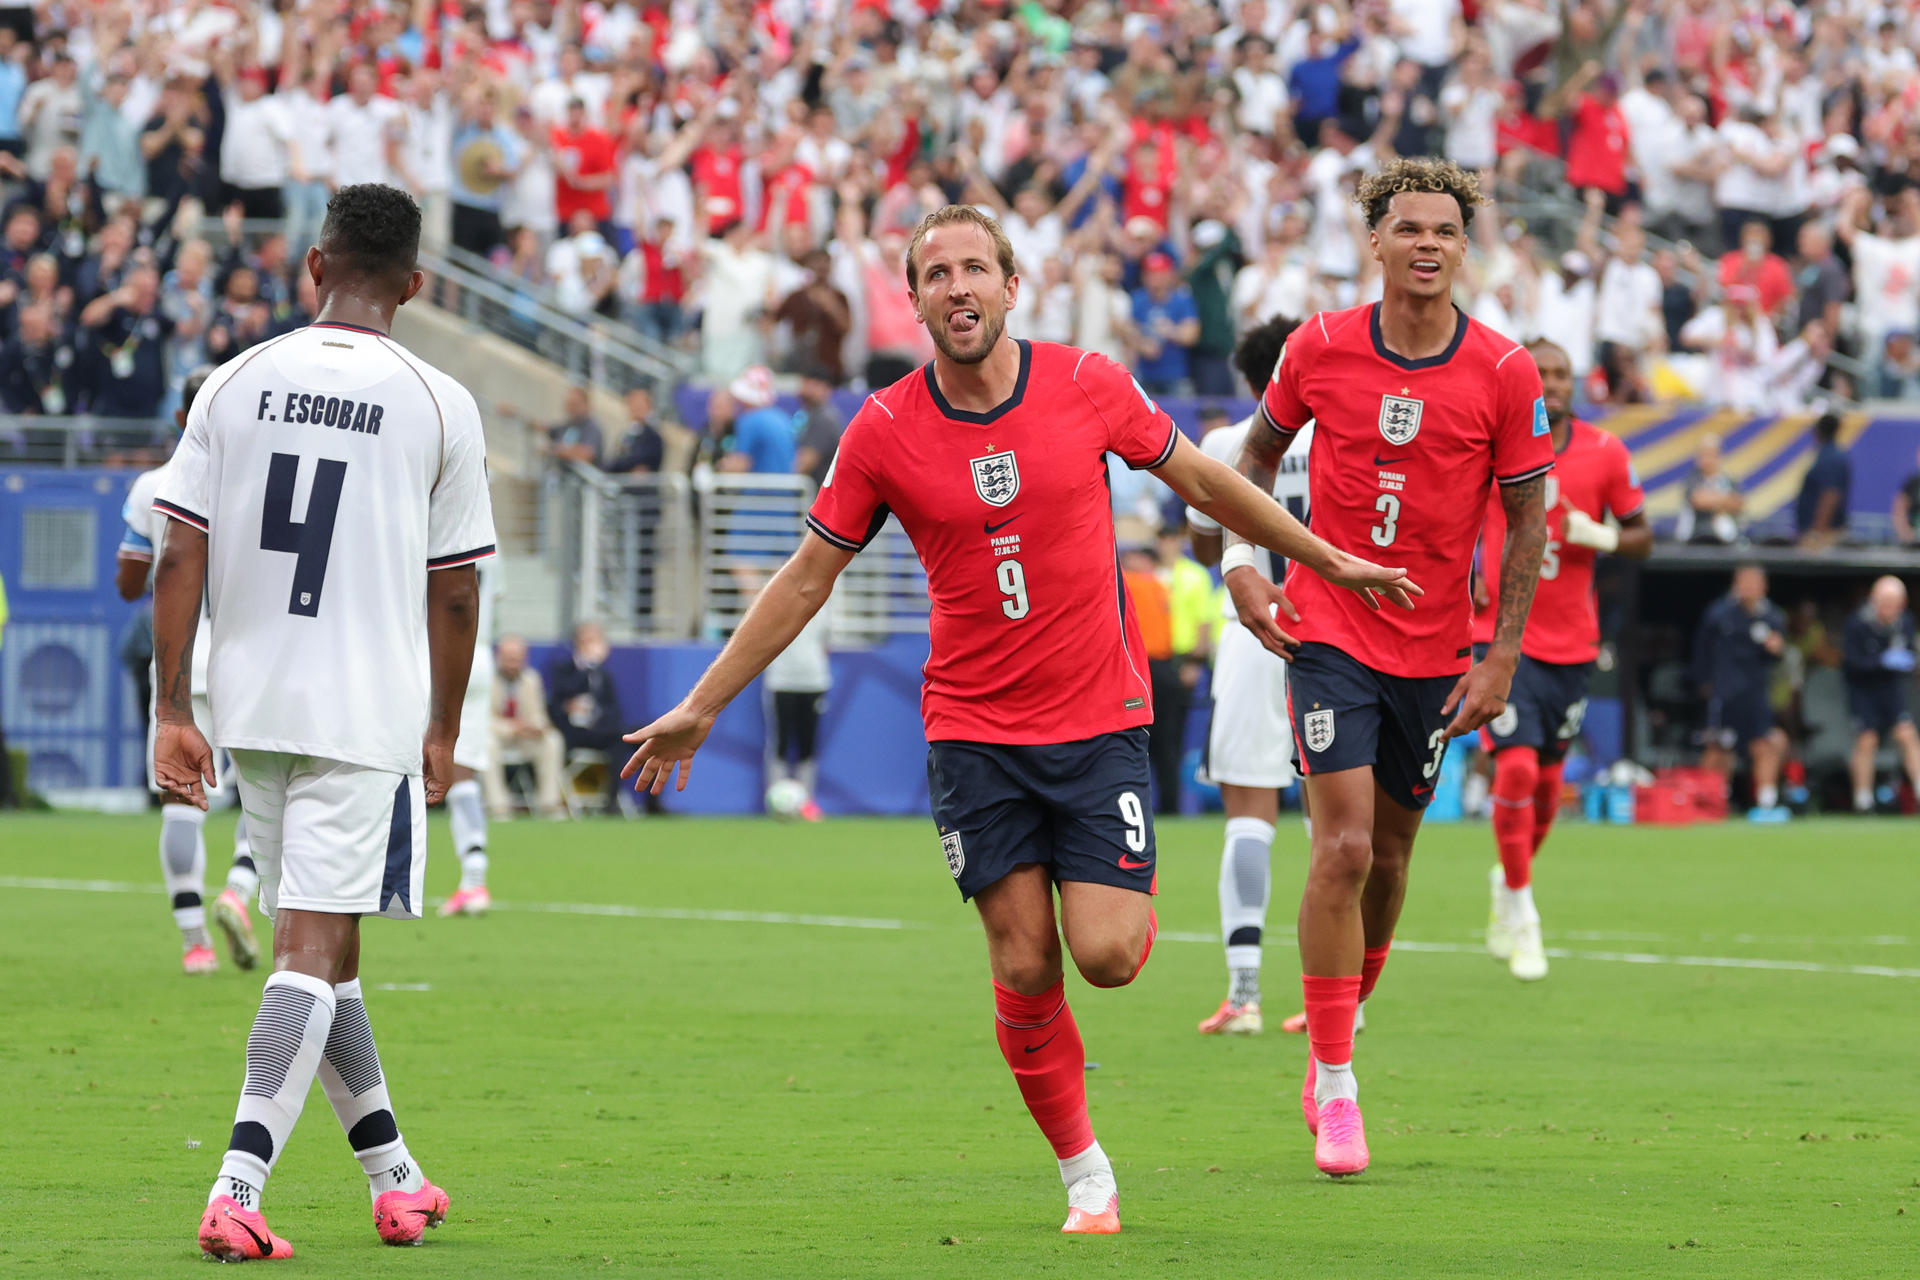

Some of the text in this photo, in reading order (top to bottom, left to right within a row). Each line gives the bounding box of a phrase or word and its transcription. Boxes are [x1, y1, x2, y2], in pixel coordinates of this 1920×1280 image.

[257, 390, 385, 436] F. ESCOBAR
[1378, 470, 1406, 483] PANAMA
[259, 452, 348, 618] 4
[990, 534, 1021, 547] PANAMA
[1370, 493, 1401, 547] 3
[996, 559, 1031, 620] 9
[1422, 728, 1446, 779] 3
[1118, 791, 1146, 852] 9
